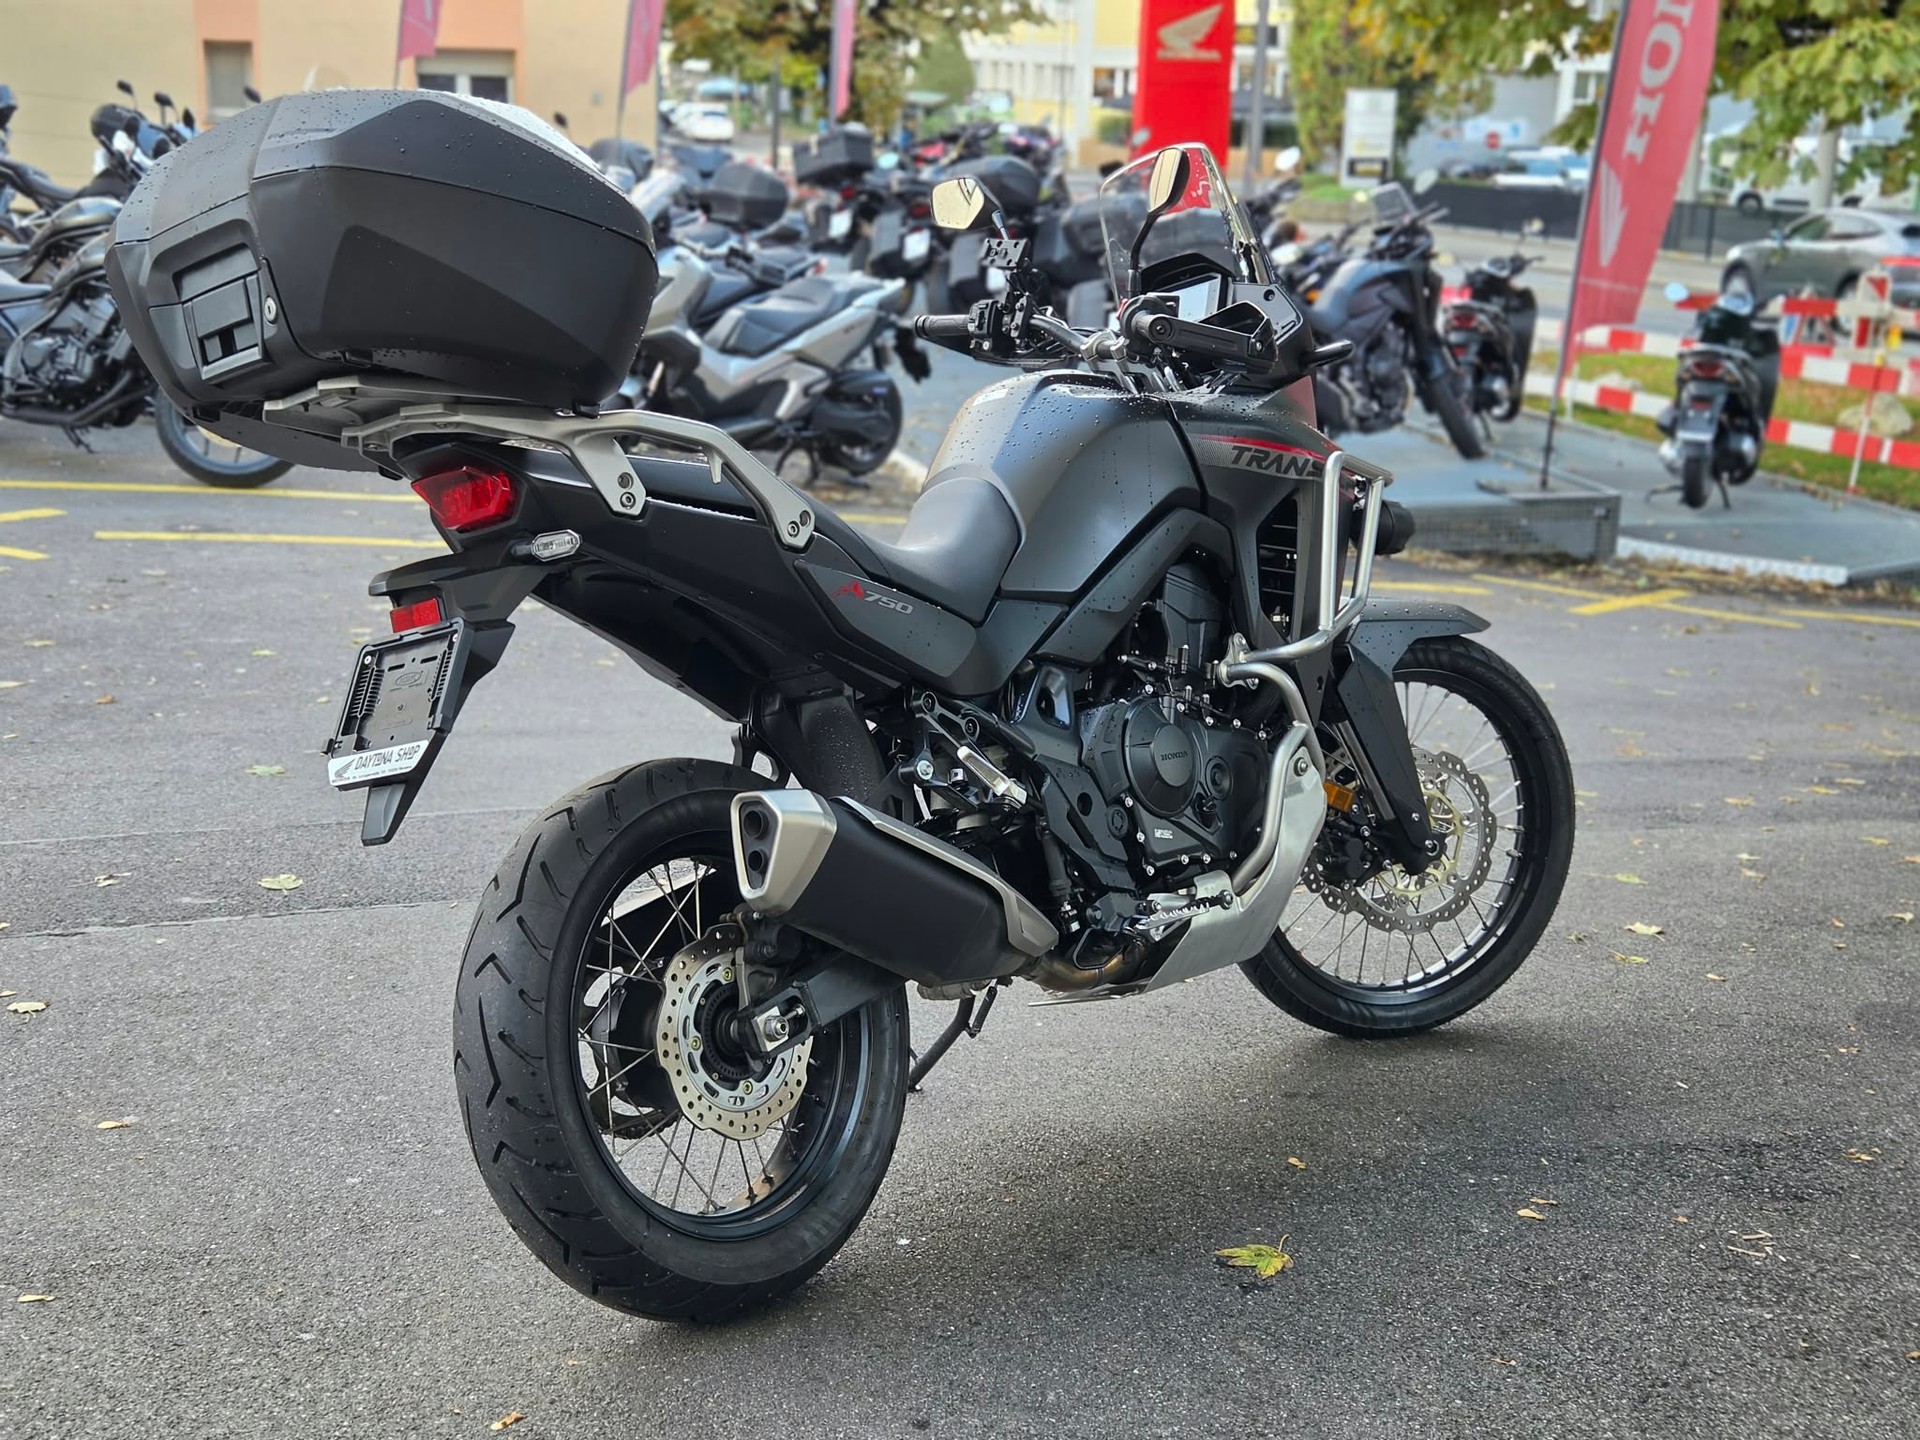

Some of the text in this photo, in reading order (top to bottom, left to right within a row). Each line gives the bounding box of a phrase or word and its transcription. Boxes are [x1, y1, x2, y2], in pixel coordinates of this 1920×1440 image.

[864, 591, 914, 615] 750
[354, 745, 421, 770] DAYTONA SHOP
[1160, 750, 1188, 761] HONDA
